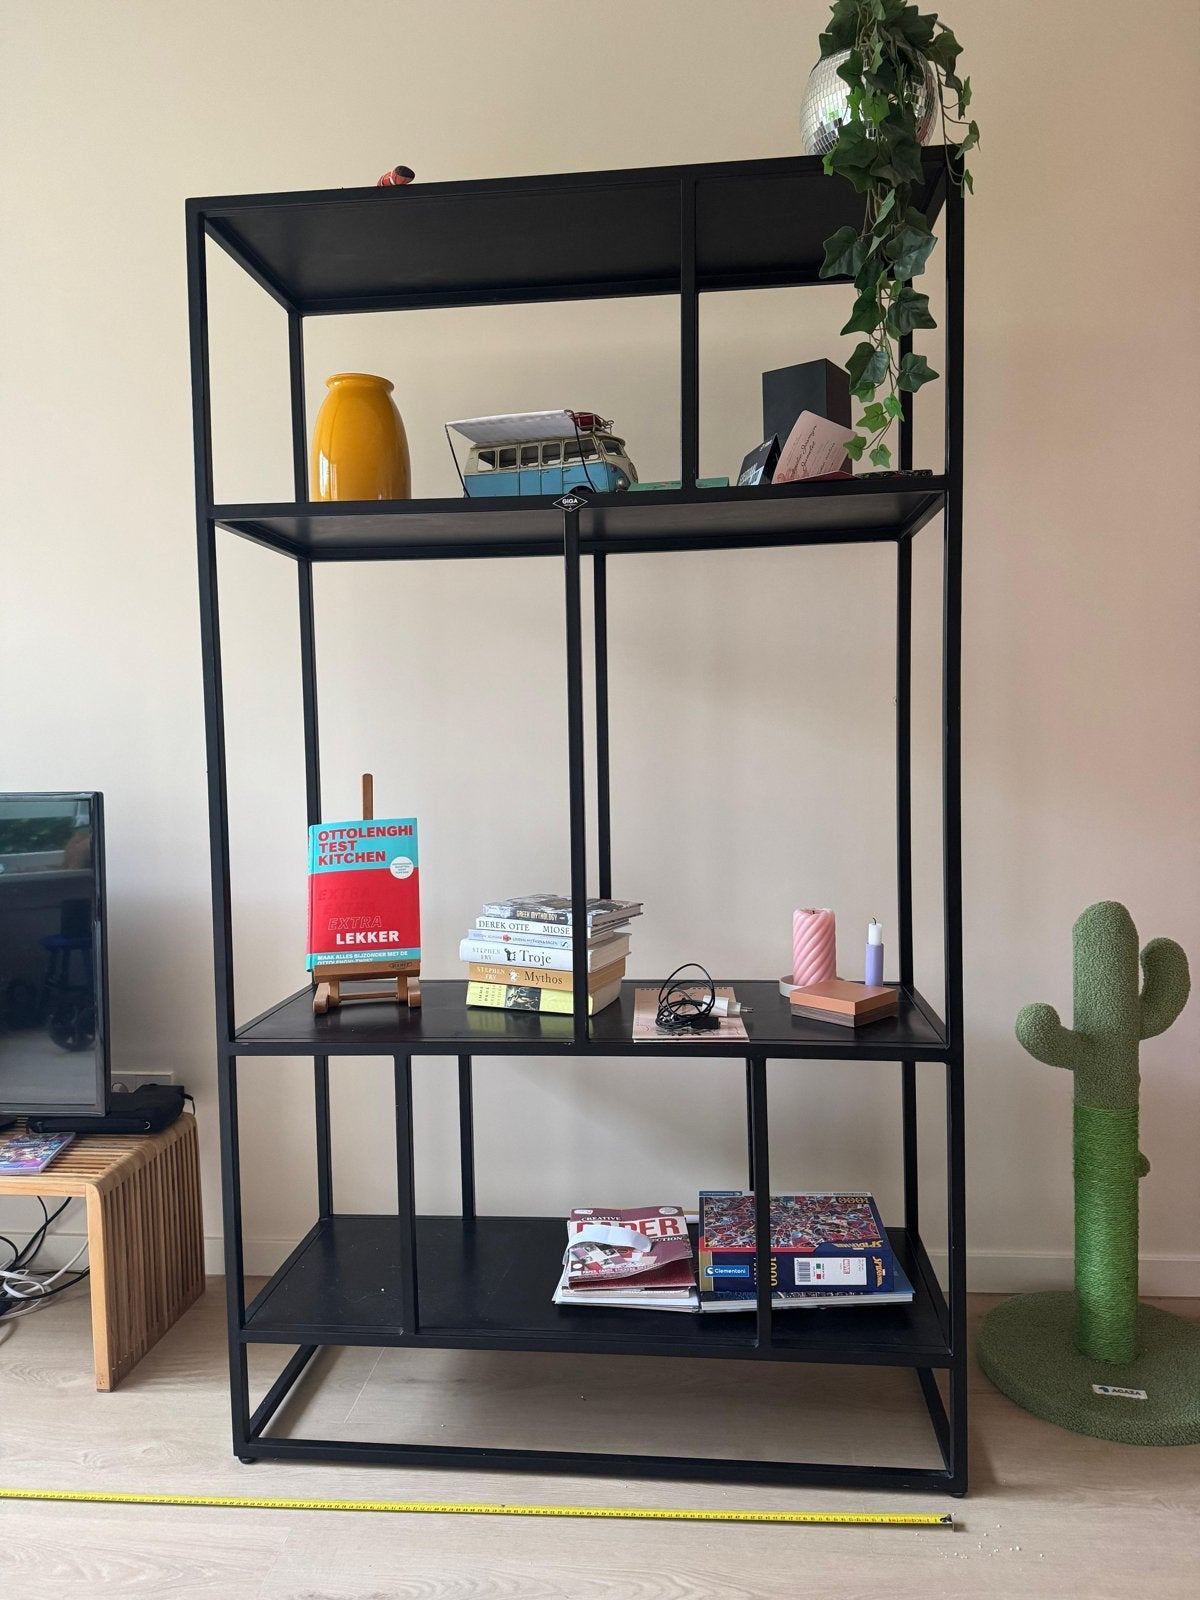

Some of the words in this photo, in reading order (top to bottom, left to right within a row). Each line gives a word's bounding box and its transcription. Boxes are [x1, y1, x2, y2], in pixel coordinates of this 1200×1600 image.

[318, 825, 413, 842] OTTOLENGHI
[319, 840, 358, 853] TEST
[318, 851, 386, 866] KITCHEN
[328, 916, 382, 930] EXTRA
[530, 912, 558, 921] MYTHOLOGY
[479, 920, 506, 929] DEREK
[509, 922, 530, 931] OTTE
[542, 926, 570, 934] MIOSE
[336, 930, 400, 945] LEKKER
[519, 950, 552, 967] Troje
[524, 971, 563, 985] Mythos
